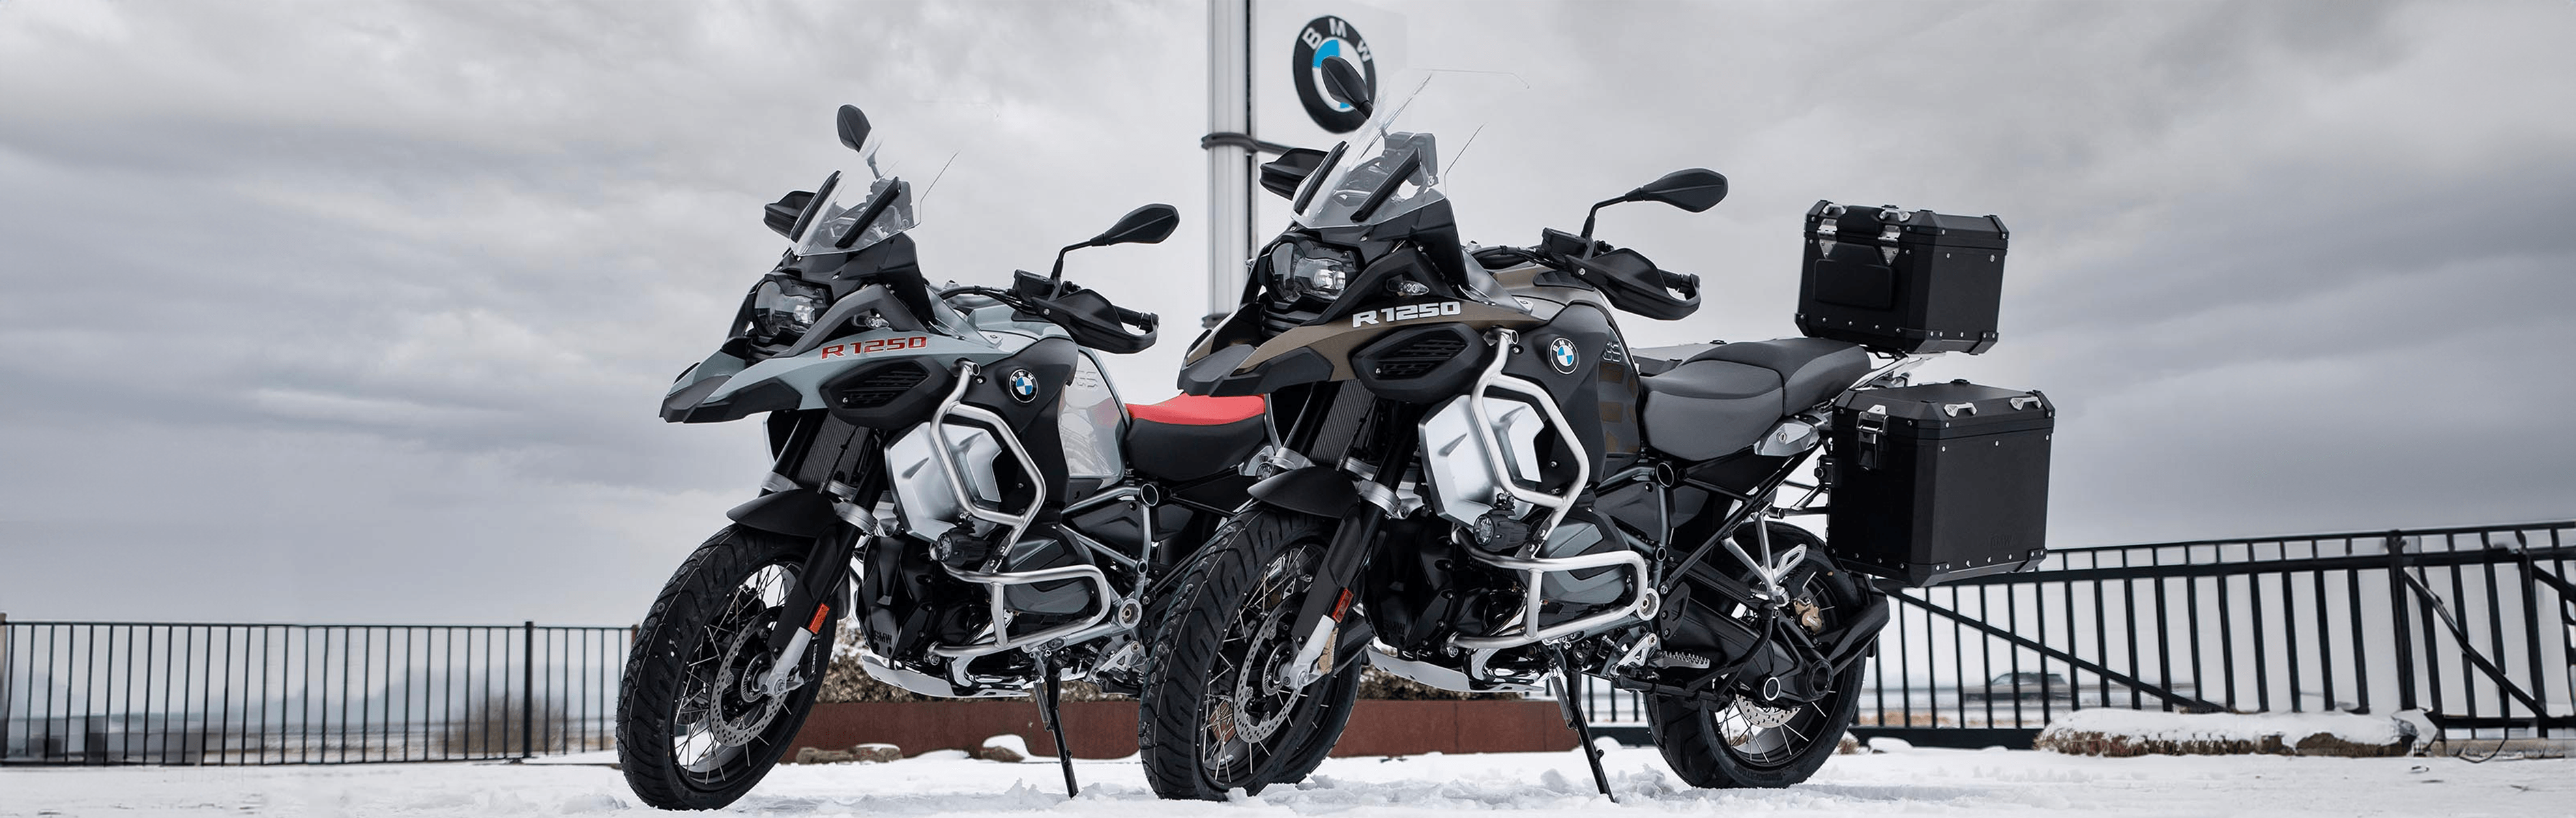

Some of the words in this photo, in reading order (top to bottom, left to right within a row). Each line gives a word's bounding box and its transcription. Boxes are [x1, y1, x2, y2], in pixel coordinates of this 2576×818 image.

[1302, 17, 1372, 62] BMW
[1352, 310, 1379, 328] R
[1381, 301, 1461, 323] 1250
[820, 344, 846, 360] R
[850, 336, 928, 355] 1250
[1552, 340, 1573, 352] BMW
[1011, 370, 1035, 382] BMW
[1075, 370, 1098, 388] GS
[873, 630, 892, 645] BMW
